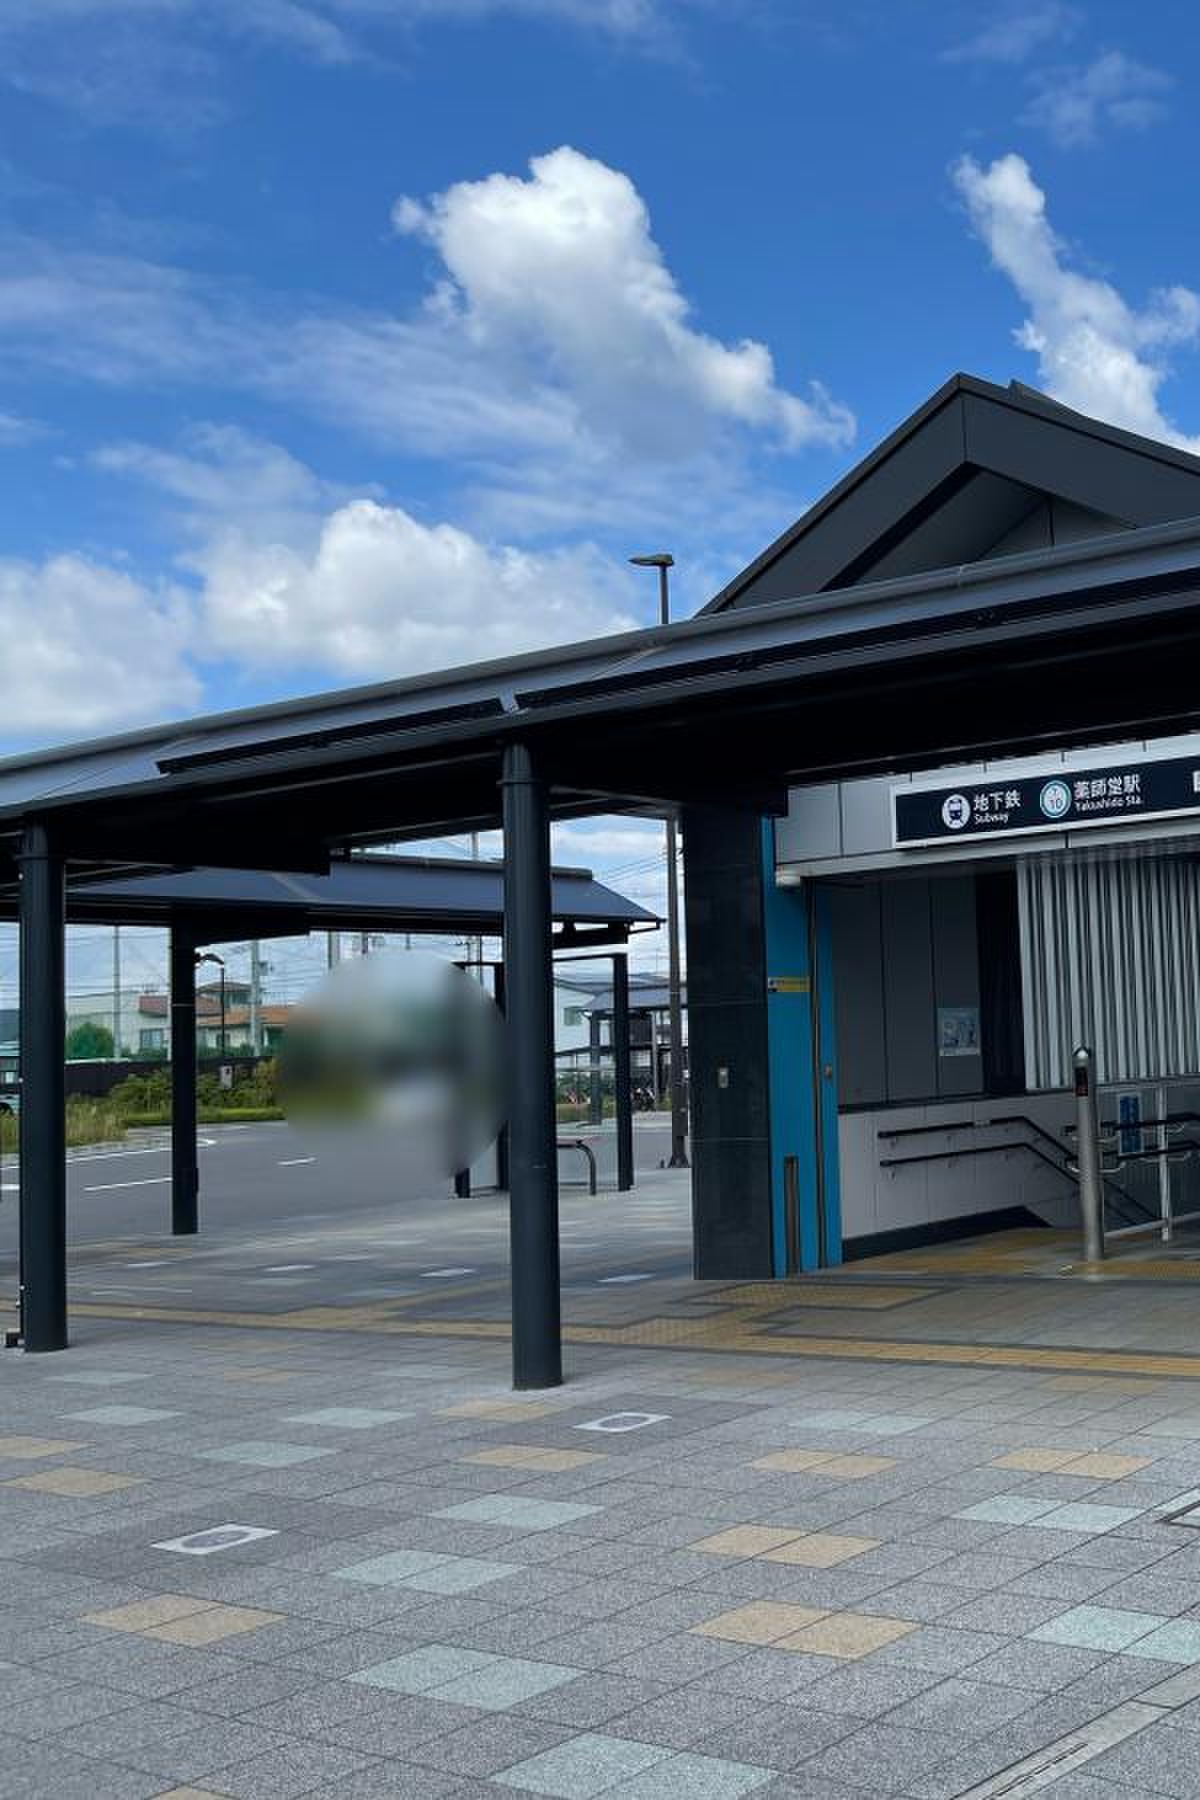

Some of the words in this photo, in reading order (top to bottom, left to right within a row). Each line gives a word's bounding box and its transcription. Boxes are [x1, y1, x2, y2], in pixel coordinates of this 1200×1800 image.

[1073, 774, 1141, 800] 薬師堂駅
[974, 790, 1021, 811] 地下鉄
[974, 812, 1009, 824] Subway
